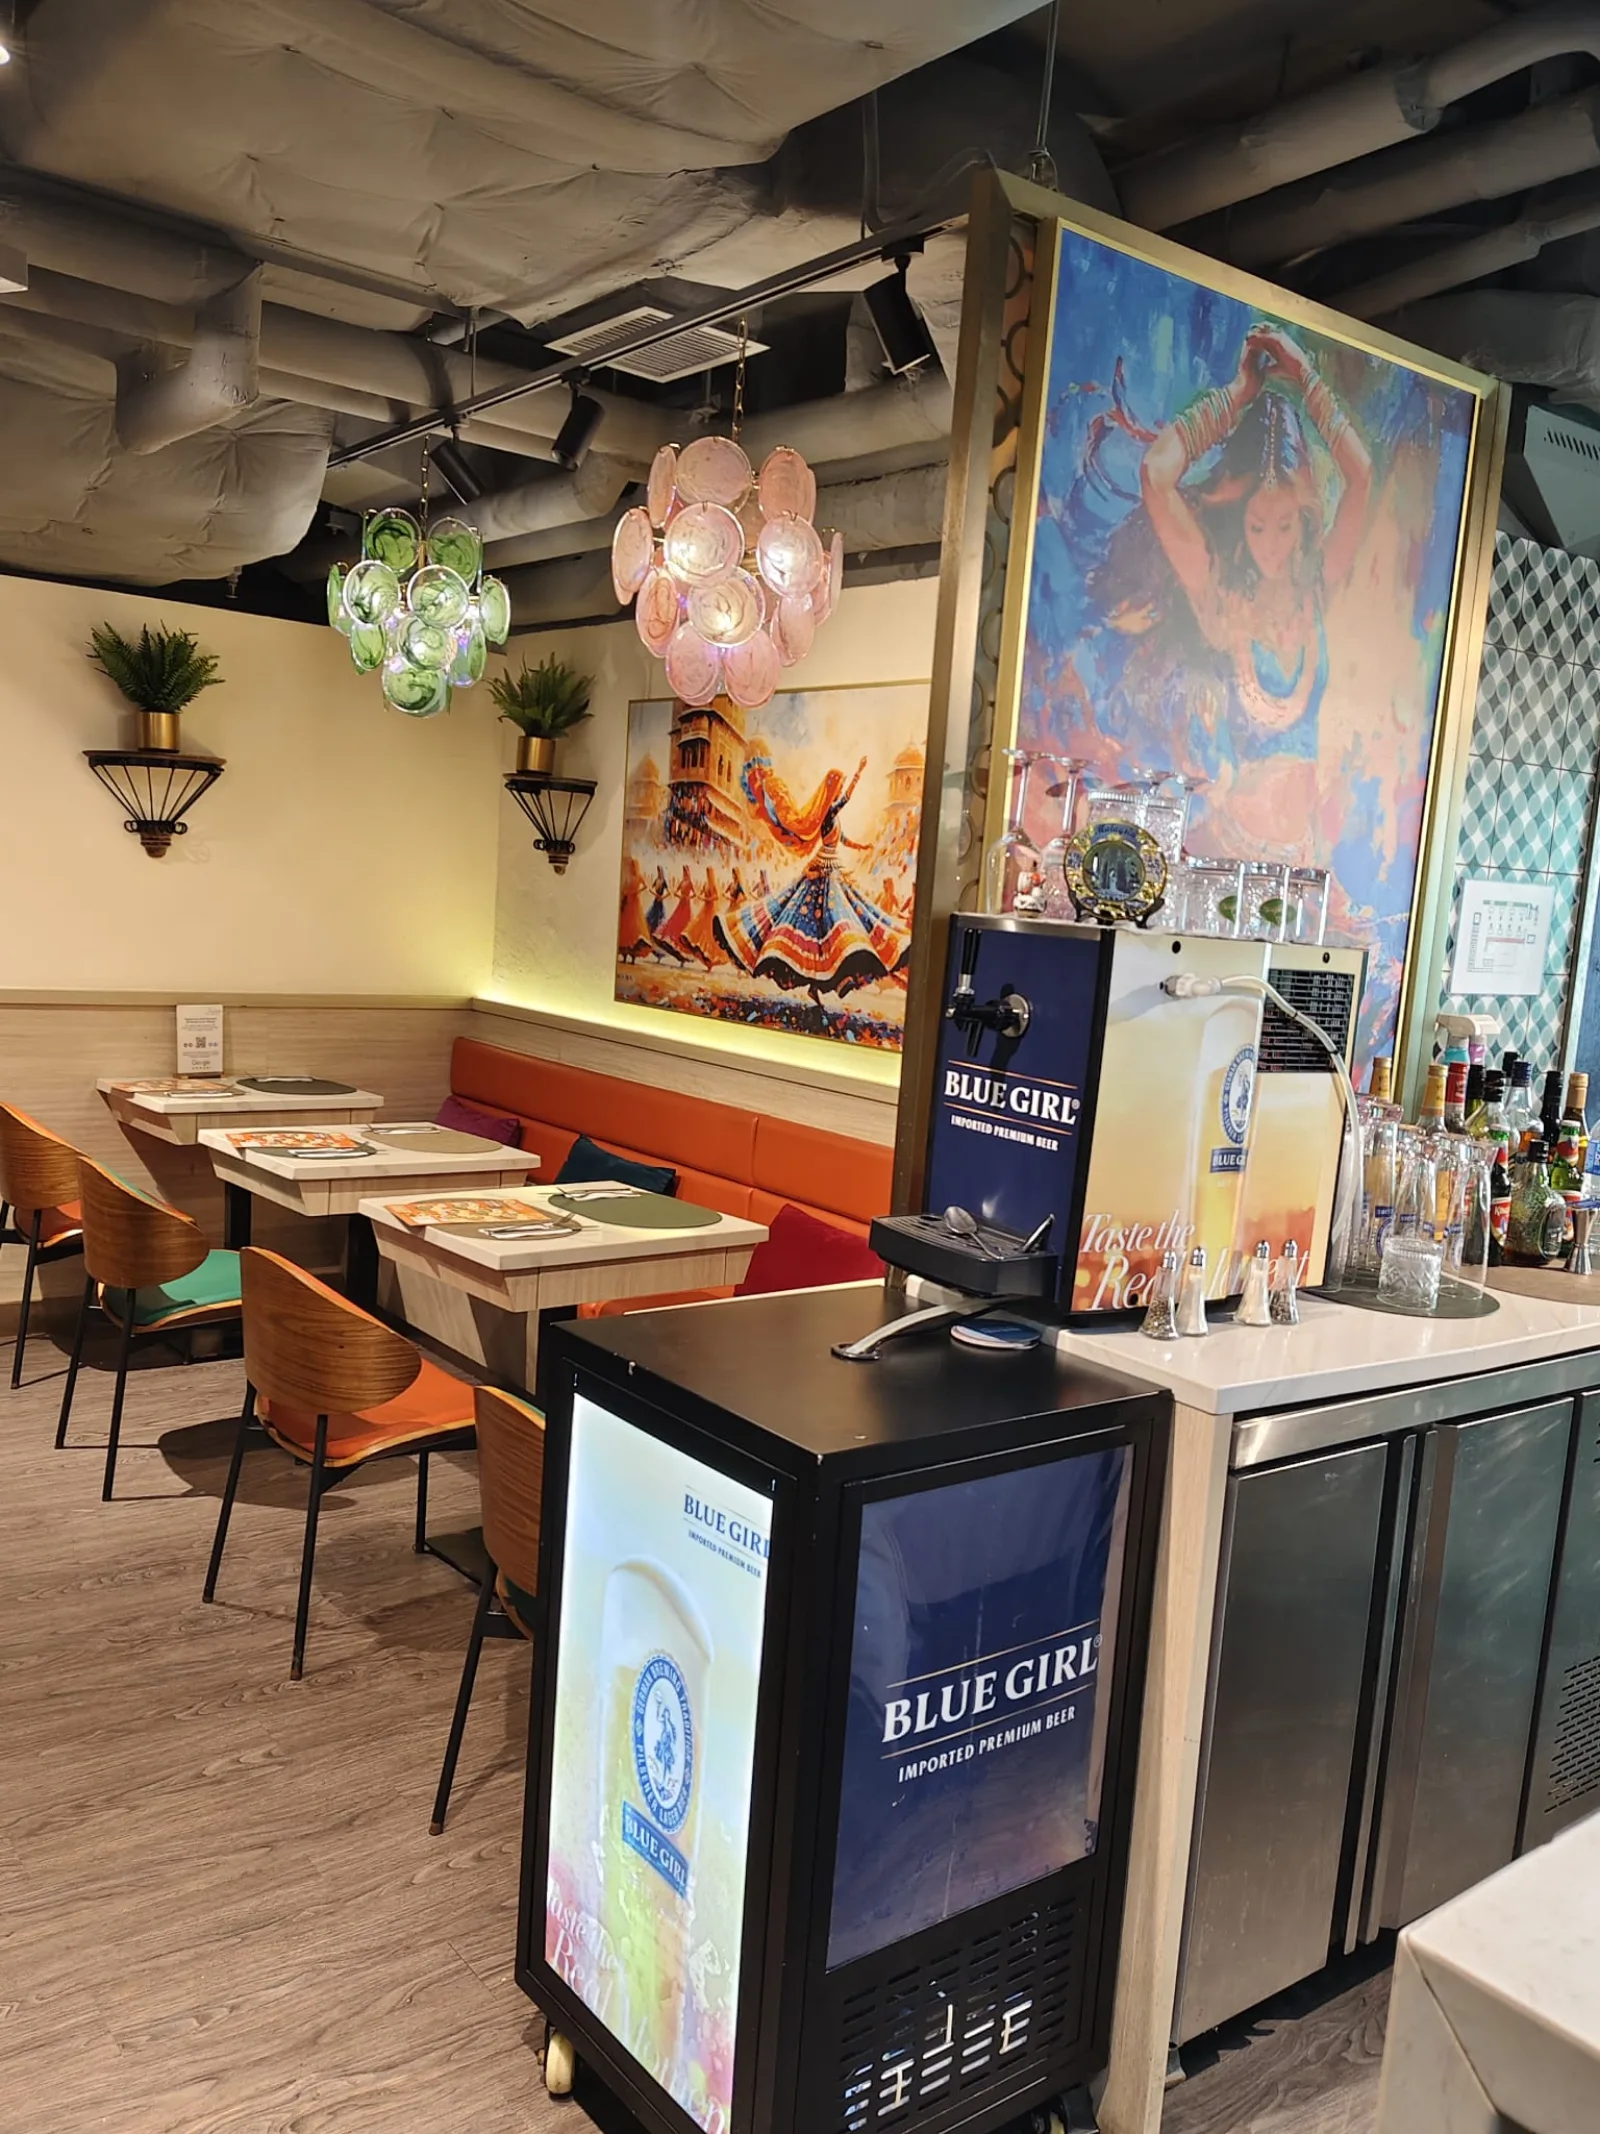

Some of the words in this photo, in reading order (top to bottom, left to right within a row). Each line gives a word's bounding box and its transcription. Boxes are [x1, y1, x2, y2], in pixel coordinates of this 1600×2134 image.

[944, 1070, 1007, 1109] BLUE
[951, 1115, 993, 1135] IMPORTED
[994, 1125, 1035, 1146] PREMIUM
[1036, 1136, 1059, 1151] BEER
[1212, 1154, 1237, 1167] BLUE
[1080, 1213, 1153, 1253] Taste
[1154, 1209, 1196, 1251] the
[683, 1493, 727, 1535] BLUE
[688, 1529, 718, 1552] IMPORTED
[718, 1546, 746, 1570] PREMIUM
[746, 1563, 762, 1578] BEER
[636, 1670, 654, 1715] GERMAN
[649, 1661, 682, 1693] BREWING
[882, 1671, 998, 1743] BLUE
[898, 1743, 974, 1783] IMPORTED
[978, 1718, 1042, 1755] PREMIUM
[1045, 1706, 1076, 1730] BEER
[636, 1744, 658, 1812] PILSENER
[624, 1814, 659, 1858] BLUE
[659, 1848, 686, 1887] GIRL
